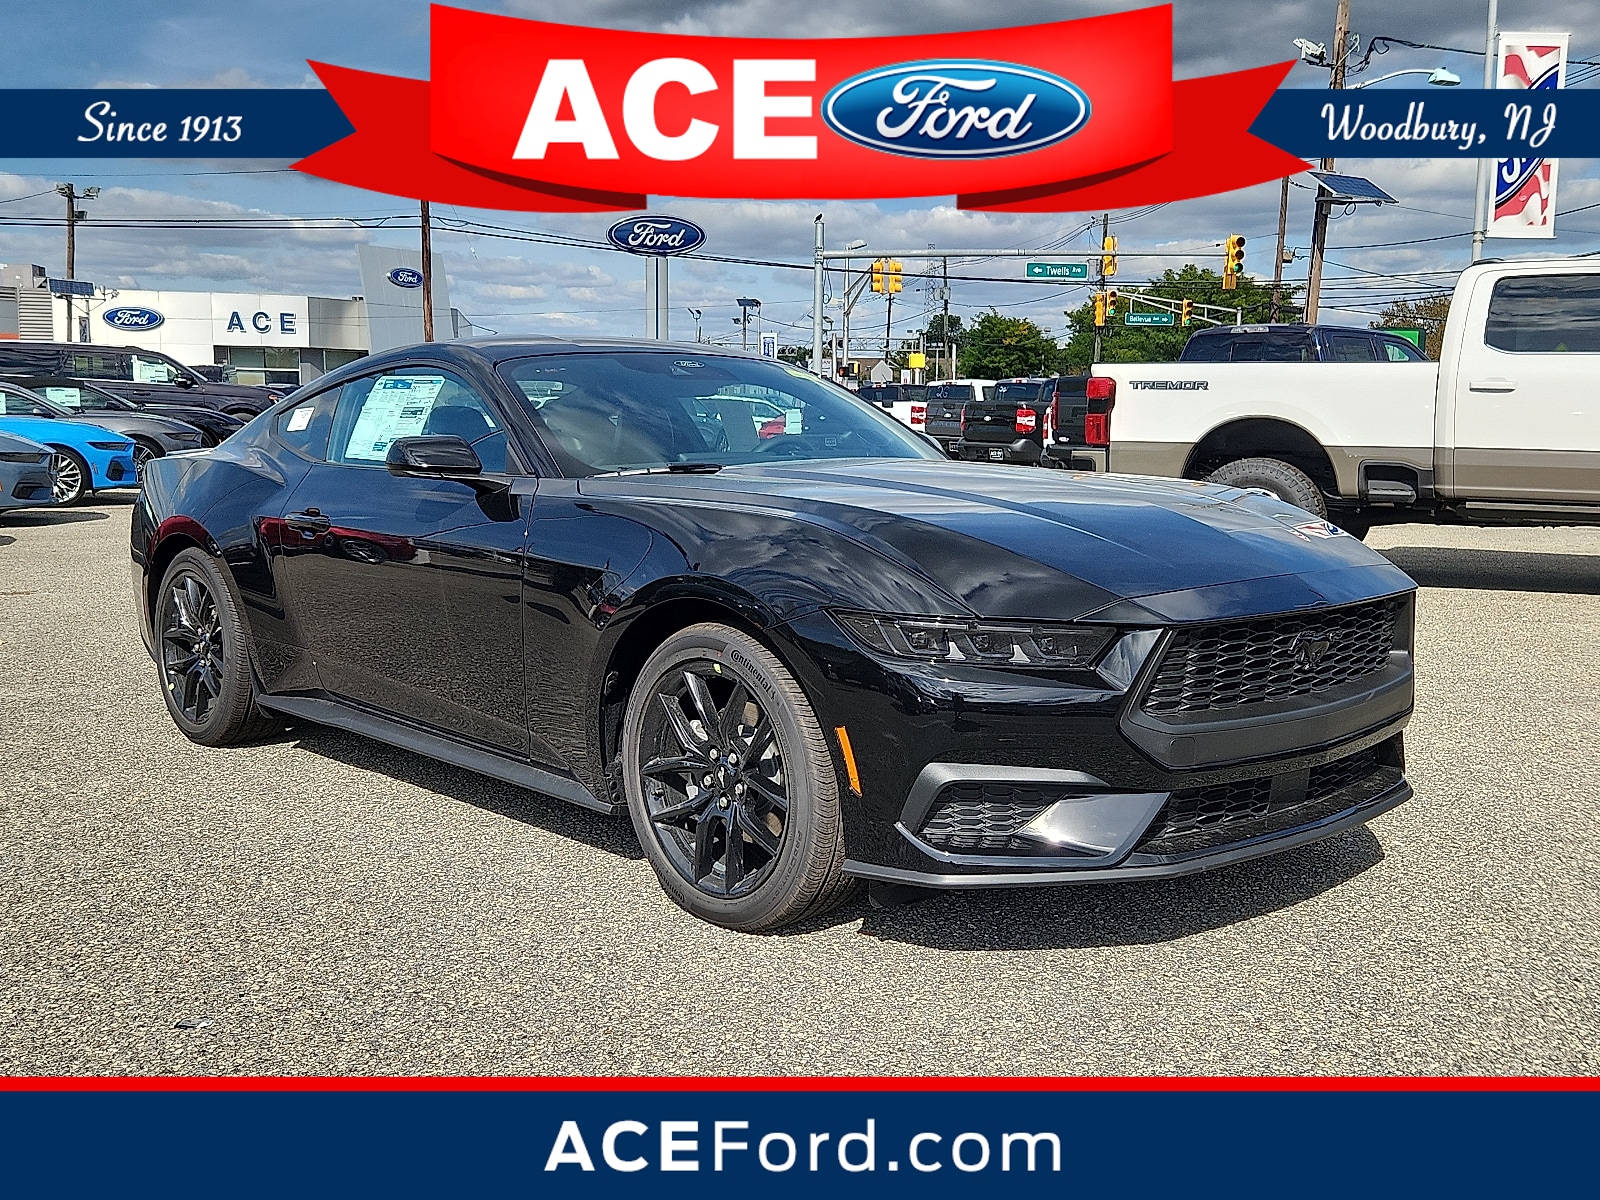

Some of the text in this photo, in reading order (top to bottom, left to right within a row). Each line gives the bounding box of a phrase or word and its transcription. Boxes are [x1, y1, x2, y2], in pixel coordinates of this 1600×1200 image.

[628, 222, 686, 247] Ford
[397, 271, 418, 283] Ford
[1046, 265, 1070, 276] Twells
[114, 309, 150, 326] Ford
[226, 311, 297, 334] ACE
[1129, 315, 1152, 323] Bellevue
[1128, 380, 1210, 391] TREMOR
[730, 649, 772, 693] Continental
